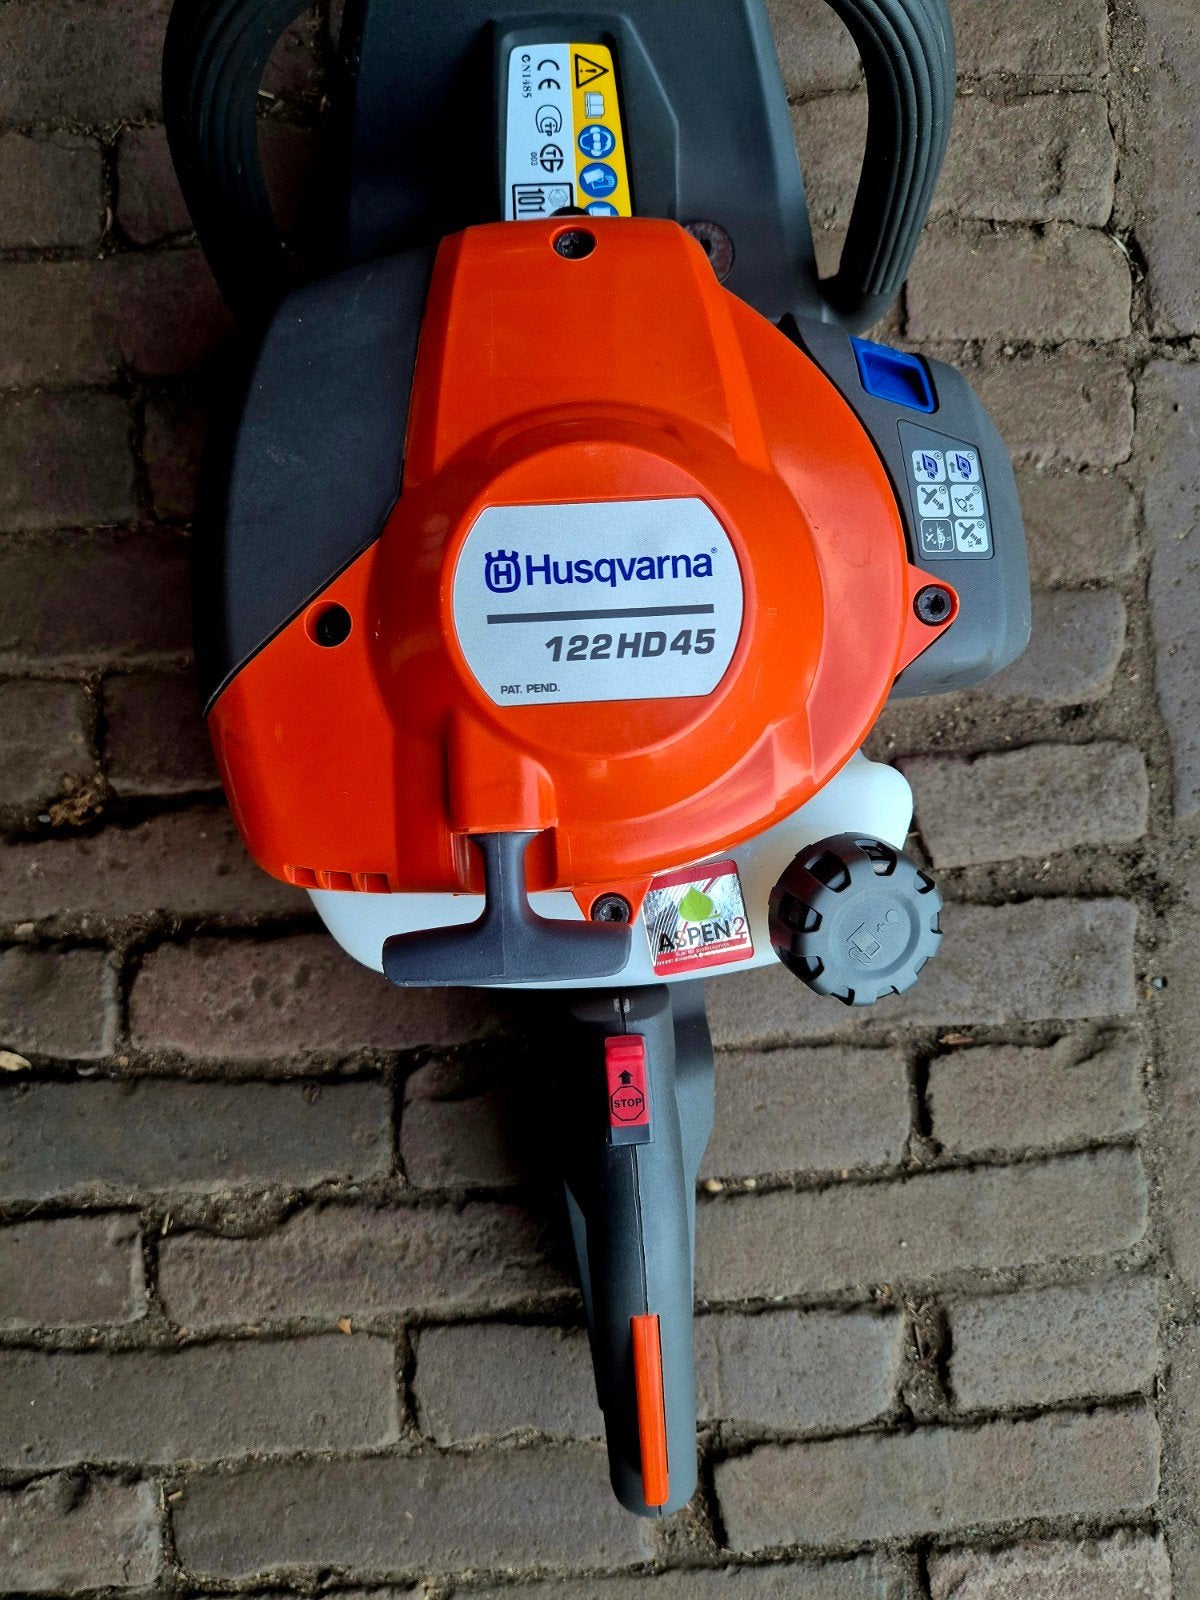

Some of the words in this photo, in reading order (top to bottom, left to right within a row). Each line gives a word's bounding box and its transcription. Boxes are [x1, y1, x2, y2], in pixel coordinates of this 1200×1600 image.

[517, 188, 546, 213] 101
[525, 552, 713, 588] Husqvarna
[500, 685, 523, 695] PAT.
[526, 683, 561, 694] PEND.
[658, 920, 731, 951] ASPEN
[613, 1098, 642, 1109] STOP
